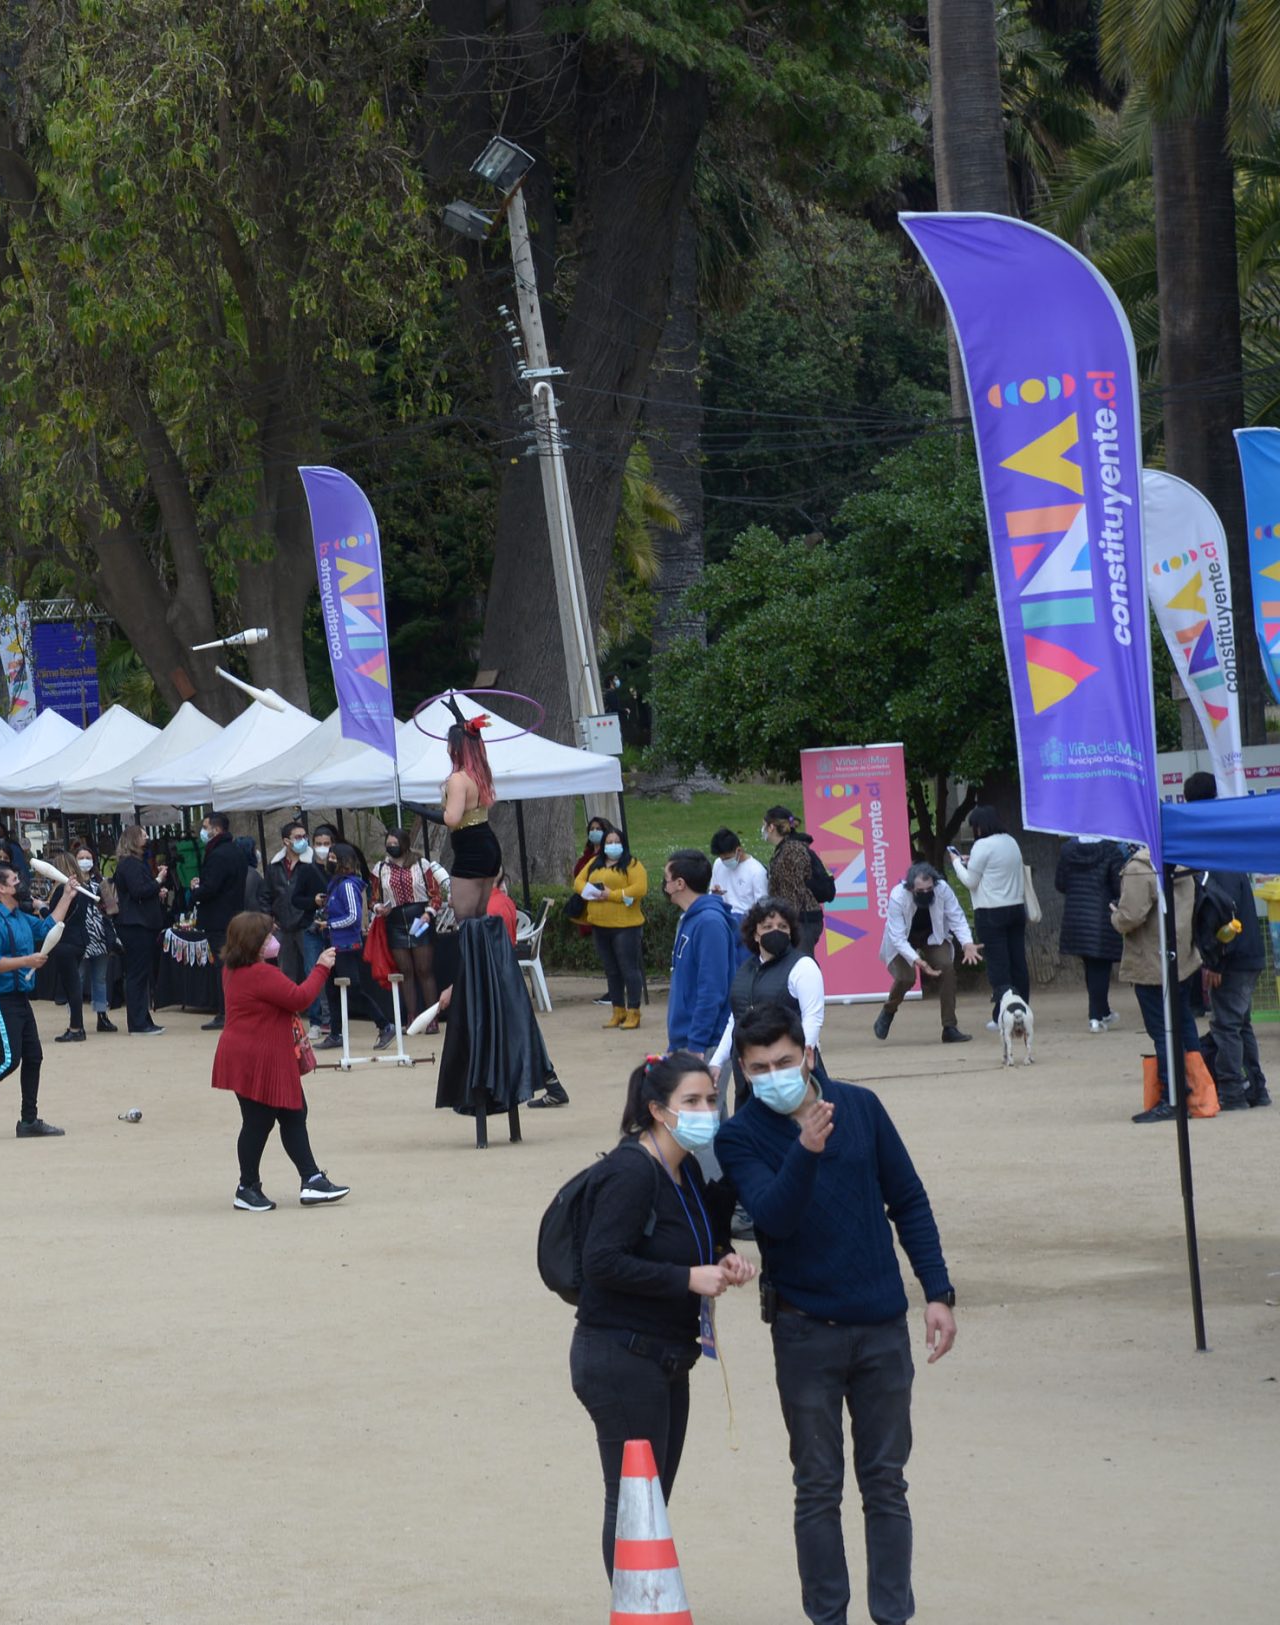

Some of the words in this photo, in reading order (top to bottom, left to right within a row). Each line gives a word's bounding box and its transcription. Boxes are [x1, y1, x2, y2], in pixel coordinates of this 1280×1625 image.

[1087, 371, 1132, 646] constituyente.cl
[1200, 541, 1237, 694] constituyente.cl
[866, 782, 889, 919] constituyente.cl
